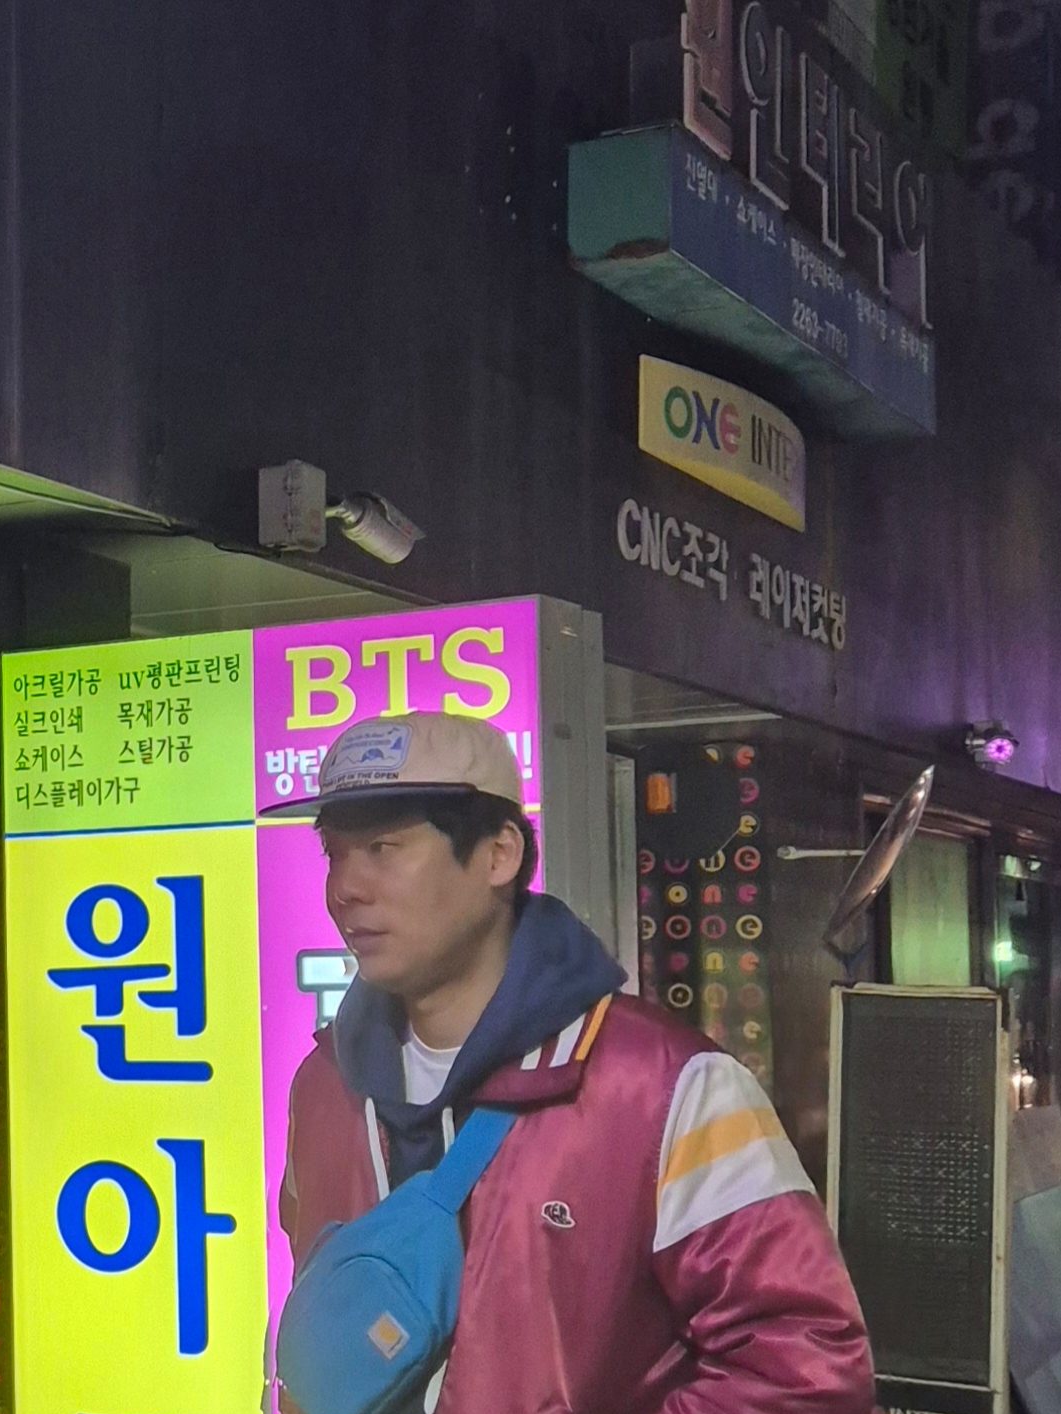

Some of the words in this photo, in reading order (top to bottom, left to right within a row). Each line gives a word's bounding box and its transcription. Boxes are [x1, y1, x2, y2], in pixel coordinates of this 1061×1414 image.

[664, 386, 741, 454] ONE
[617, 498, 730, 601] CNC조각
[13, 668, 102, 701] 아크릴가공
[285, 627, 512, 731] BTS
[14, 705, 84, 737] 실크인쇄
[117, 697, 193, 729] 목재가공
[15, 744, 85, 773] 쇼케이스
[118, 735, 193, 765] 스틸가공
[16, 776, 141, 810] 디스플레이가구
